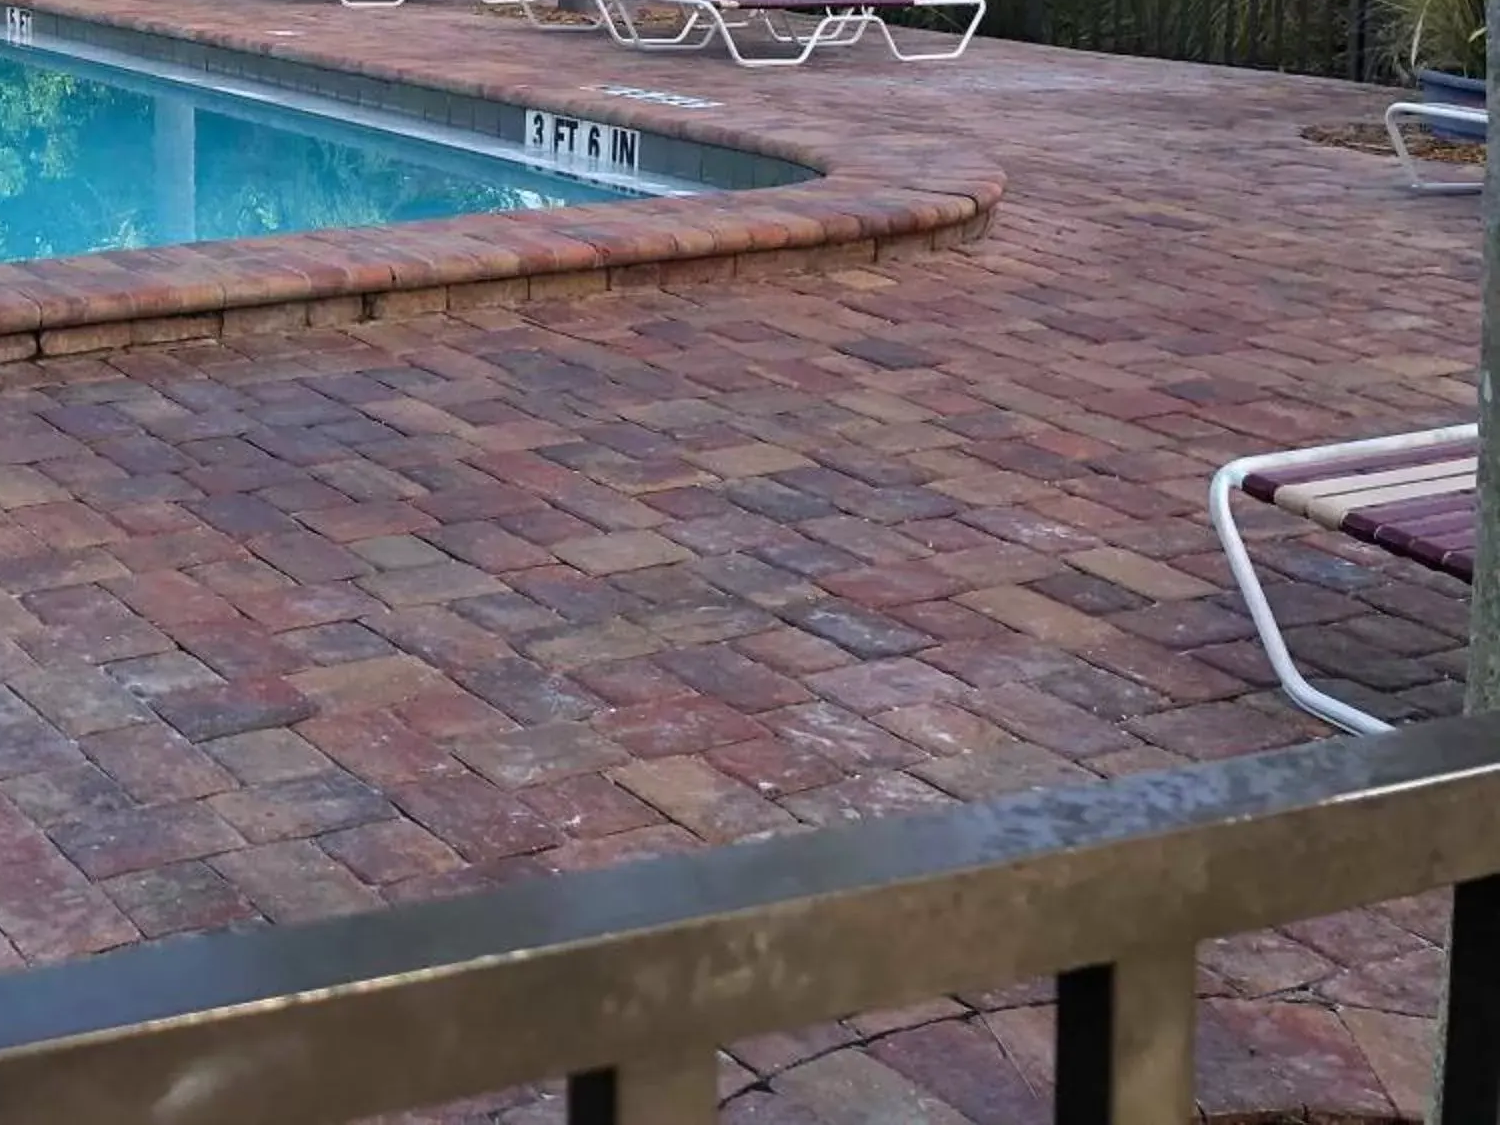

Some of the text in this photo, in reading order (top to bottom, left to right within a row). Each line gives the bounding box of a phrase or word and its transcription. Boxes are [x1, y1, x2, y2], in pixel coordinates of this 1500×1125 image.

[19, 10, 31, 27] FT
[532, 113, 636, 167] 3 FT 6 IN
